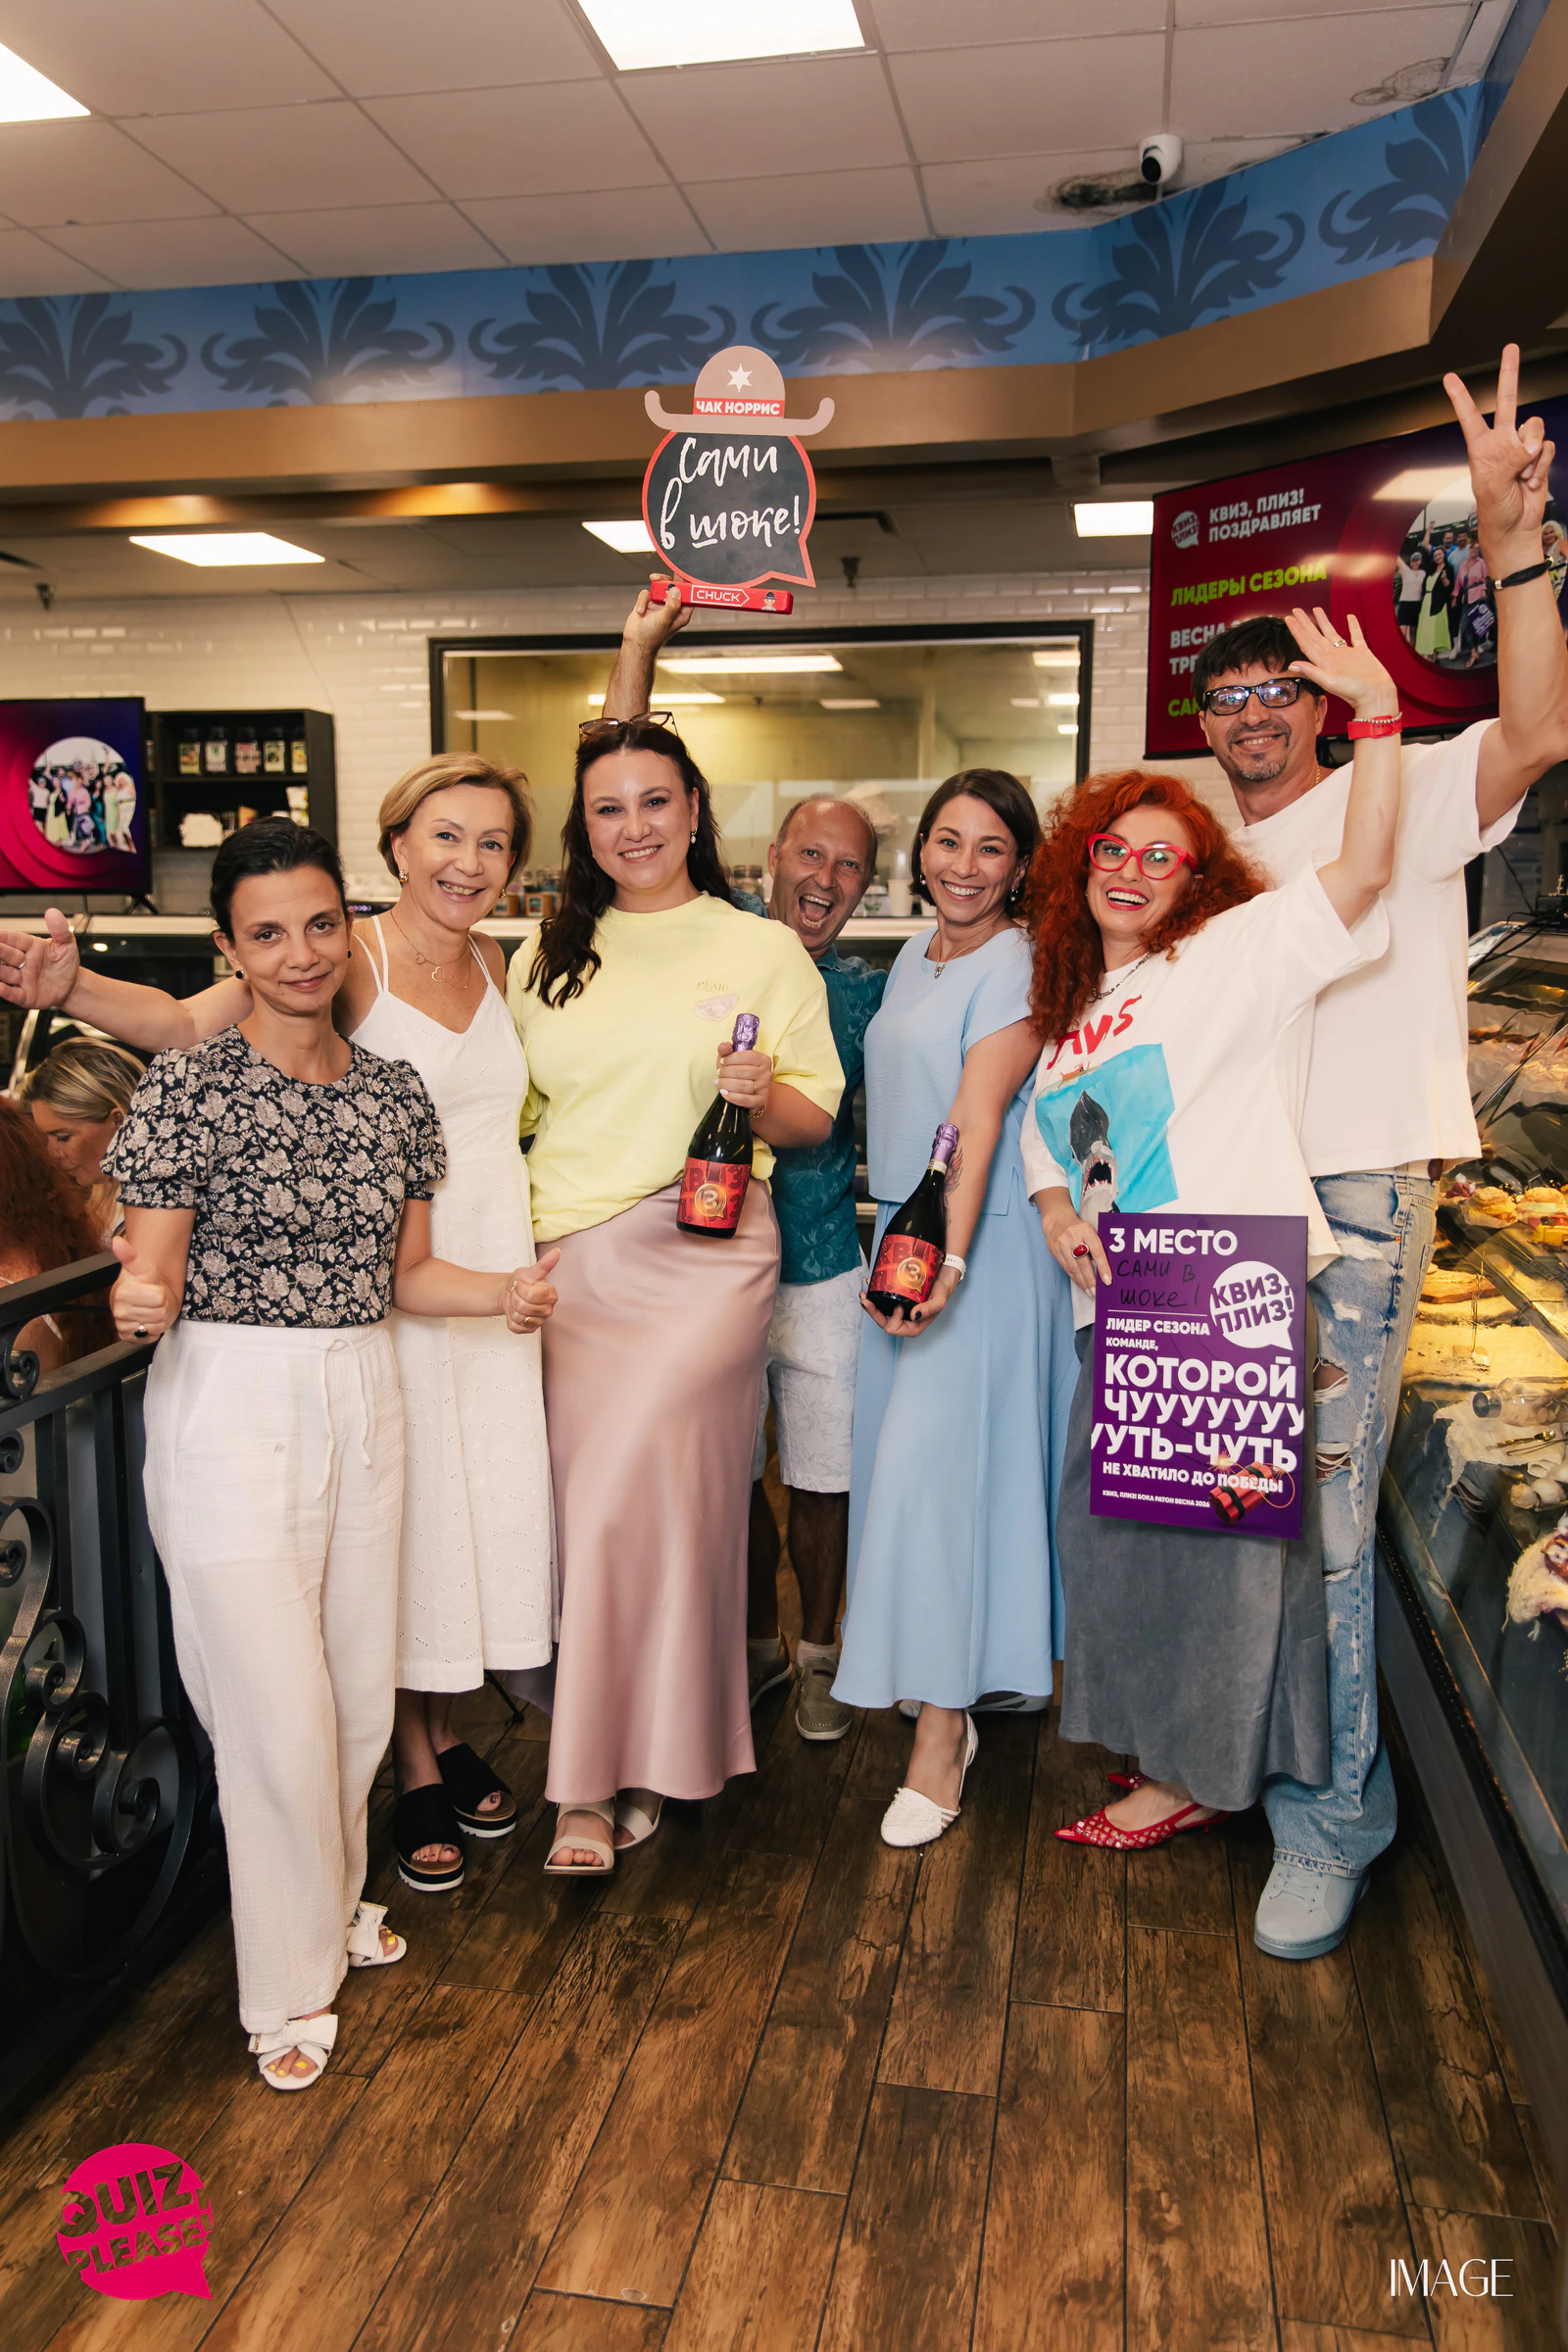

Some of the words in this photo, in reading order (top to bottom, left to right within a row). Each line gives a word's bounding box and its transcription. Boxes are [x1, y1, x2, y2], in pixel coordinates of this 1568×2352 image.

[696, 400, 722, 413] ЧАК
[725, 401, 780, 416] НОРРИС
[679, 437, 778, 486] Сами
[689, 495, 801, 548] шоке!
[1209, 501, 1253, 524] КВИЗ,
[1256, 488, 1305, 514] ПЛИЗ!
[1208, 504, 1321, 543] ПОЗДРАВЛЯЕТ
[696, 589, 741, 603] CHUCK
[1170, 575, 1246, 607] ЛИДЕРЫ
[1250, 561, 1327, 592] СЕЗОНА
[1108, 1228, 1126, 1253] 3
[1133, 1228, 1238, 1256] МЕСТО
[1116, 1259, 1171, 1278] САМИ
[1105, 1318, 1152, 1334] ЛИДЕР
[1153, 1320, 1210, 1336] СЕЗОНА
[1214, 1297, 1294, 1334] ПЛИЗ!
[1105, 1337, 1158, 1350] КОМАНДЕ,
[1105, 1353, 1297, 1398] КОТОРОЙ
[1102, 1461, 1121, 1475] НЕ
[1122, 1463, 1189, 1483] ХВАТИЛО
[1192, 1472, 1215, 1487] ДО
[1217, 1474, 1284, 1494] ПОБЕДЫ
[1137, 1494, 1154, 1502] БОКА
[1154, 1495, 1174, 1504] РАТОН
[1174, 1497, 1195, 1506] ВЕСНА
